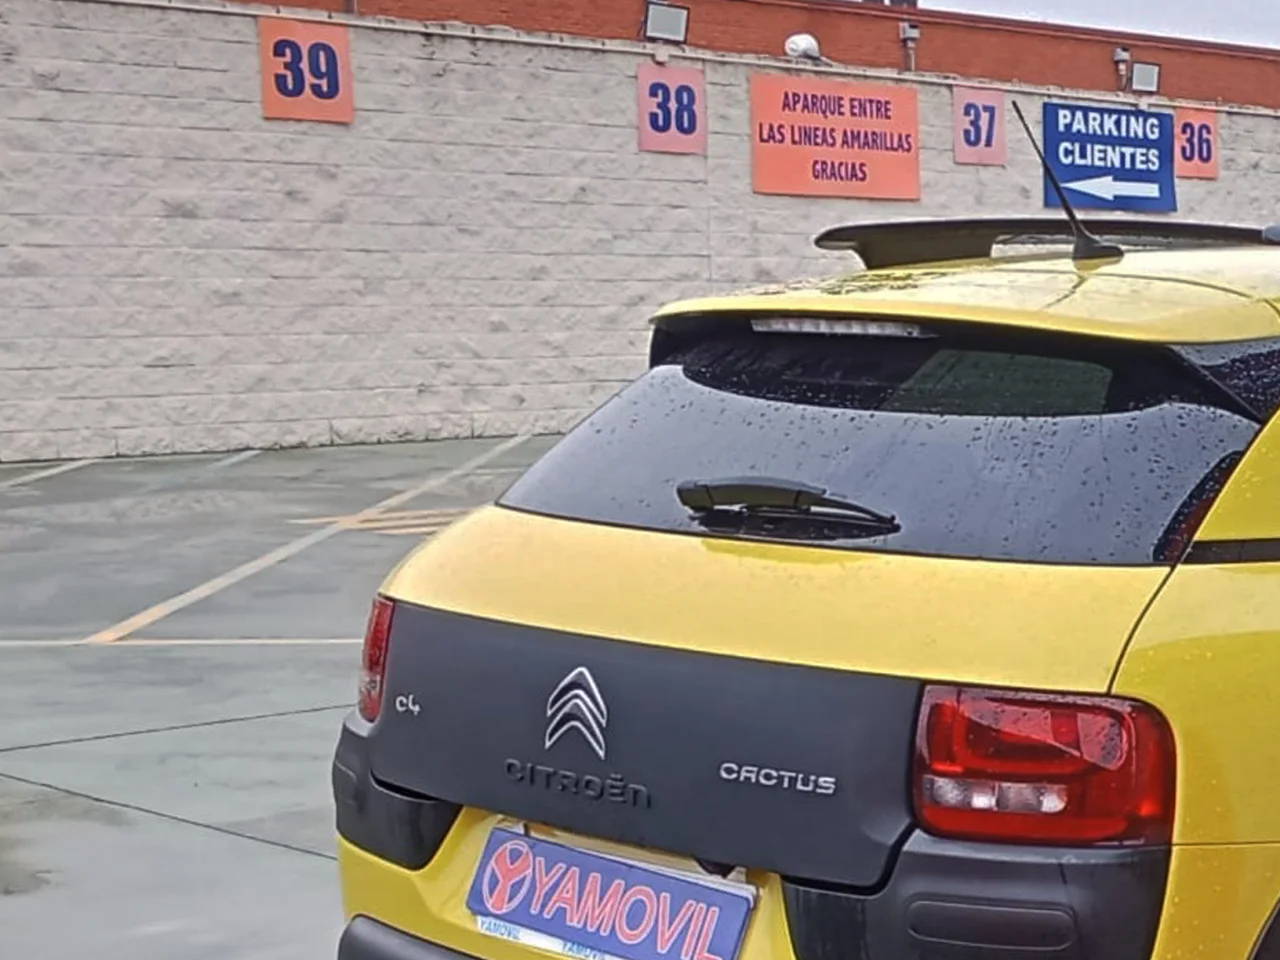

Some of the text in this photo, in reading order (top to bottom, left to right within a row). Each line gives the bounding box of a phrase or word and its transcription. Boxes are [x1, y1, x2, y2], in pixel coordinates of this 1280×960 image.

[272, 39, 341, 100] 39
[648, 82, 697, 135] 38
[782, 91, 892, 120] APARQUE ENTRE
[758, 123, 913, 153] LAS LINEAS AMARILLAS
[963, 103, 996, 148] 37
[1058, 109, 1160, 140] PARKING
[1058, 142, 1160, 170] CLIENTES
[1180, 122, 1212, 163] 36
[811, 159, 867, 183] GRACIAS
[395, 694, 421, 716] C4
[720, 762, 837, 795] CACTUS
[479, 918, 521, 942] YAMOVIL
